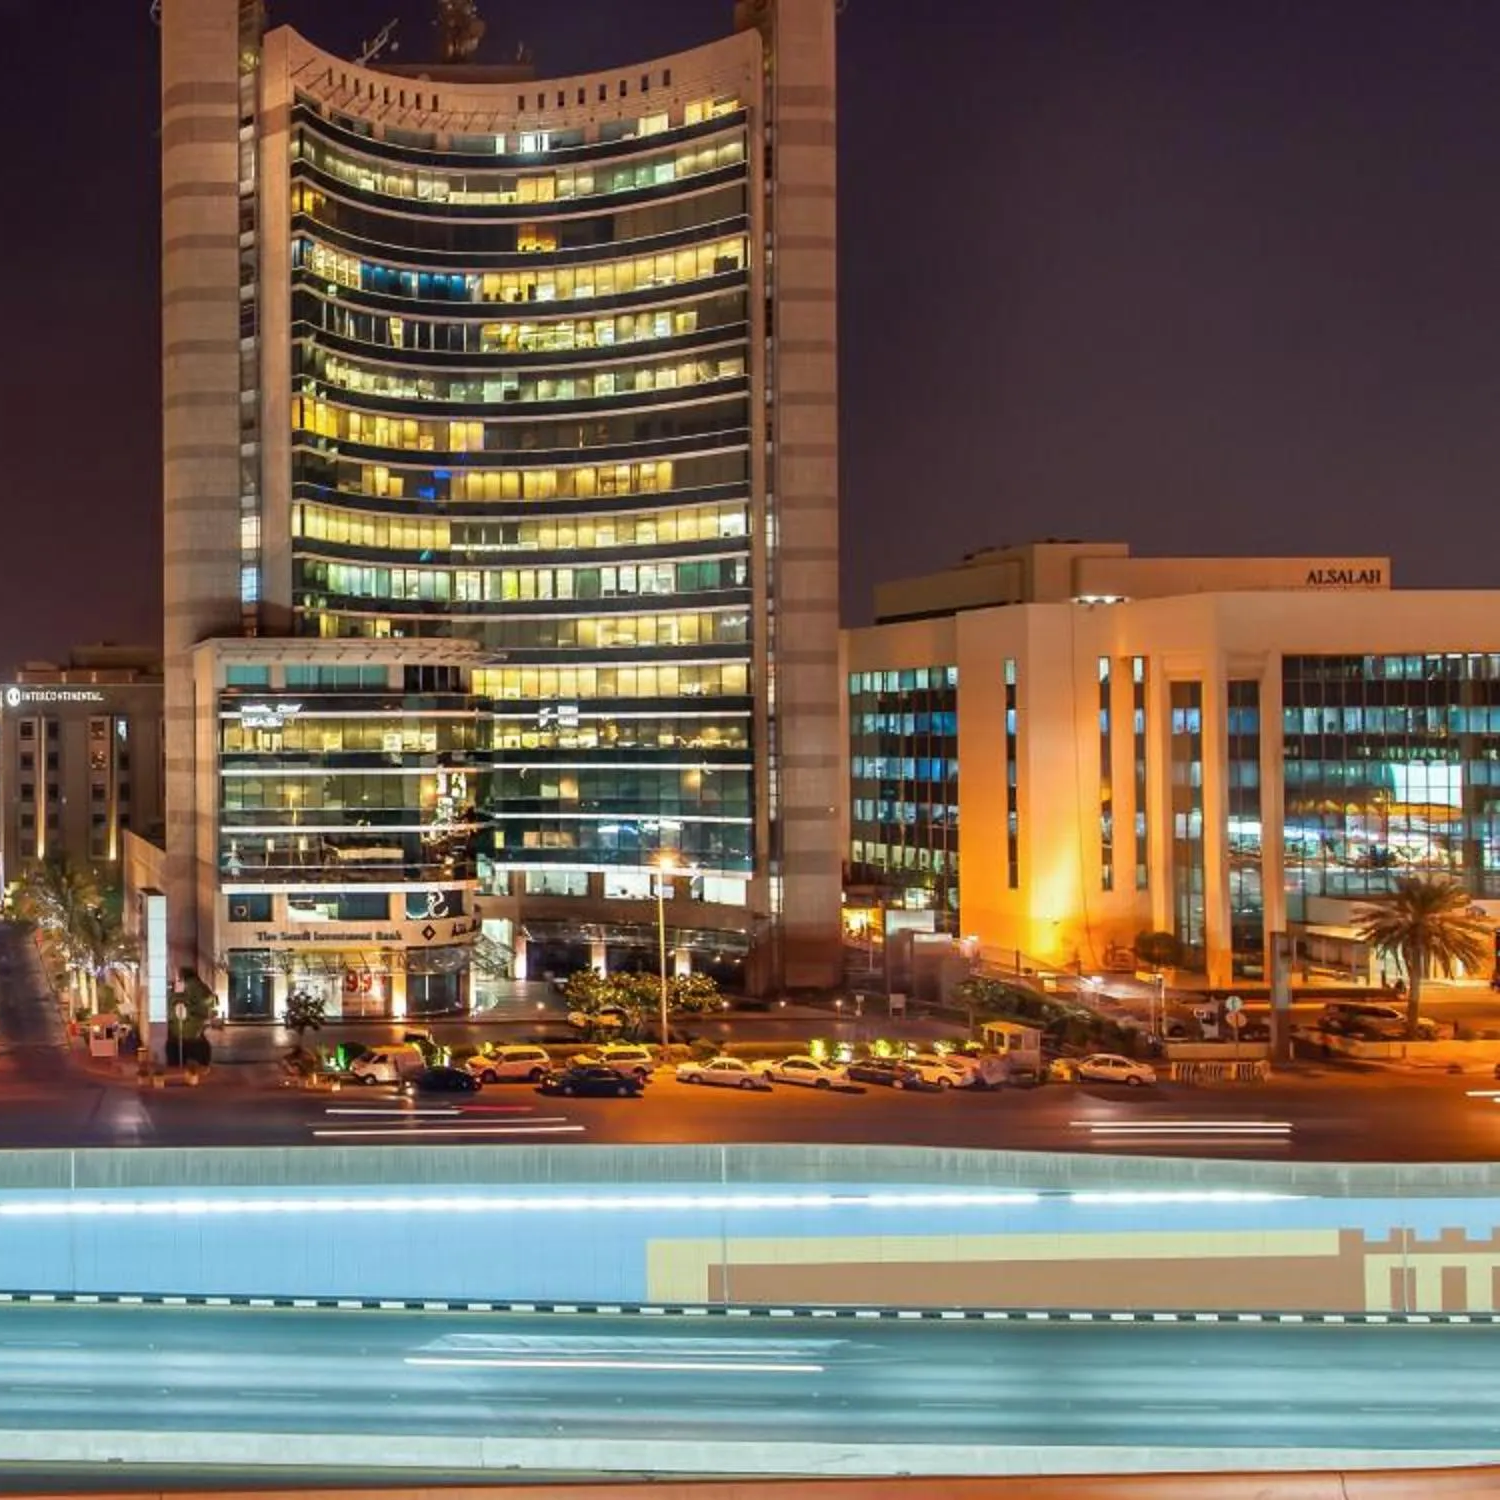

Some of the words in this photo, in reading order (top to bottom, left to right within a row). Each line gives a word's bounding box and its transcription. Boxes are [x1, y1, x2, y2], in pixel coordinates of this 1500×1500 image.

[1306, 568, 1381, 584] ALSALAH
[256, 931, 277, 941] The
[375, 930, 402, 941] Bank
